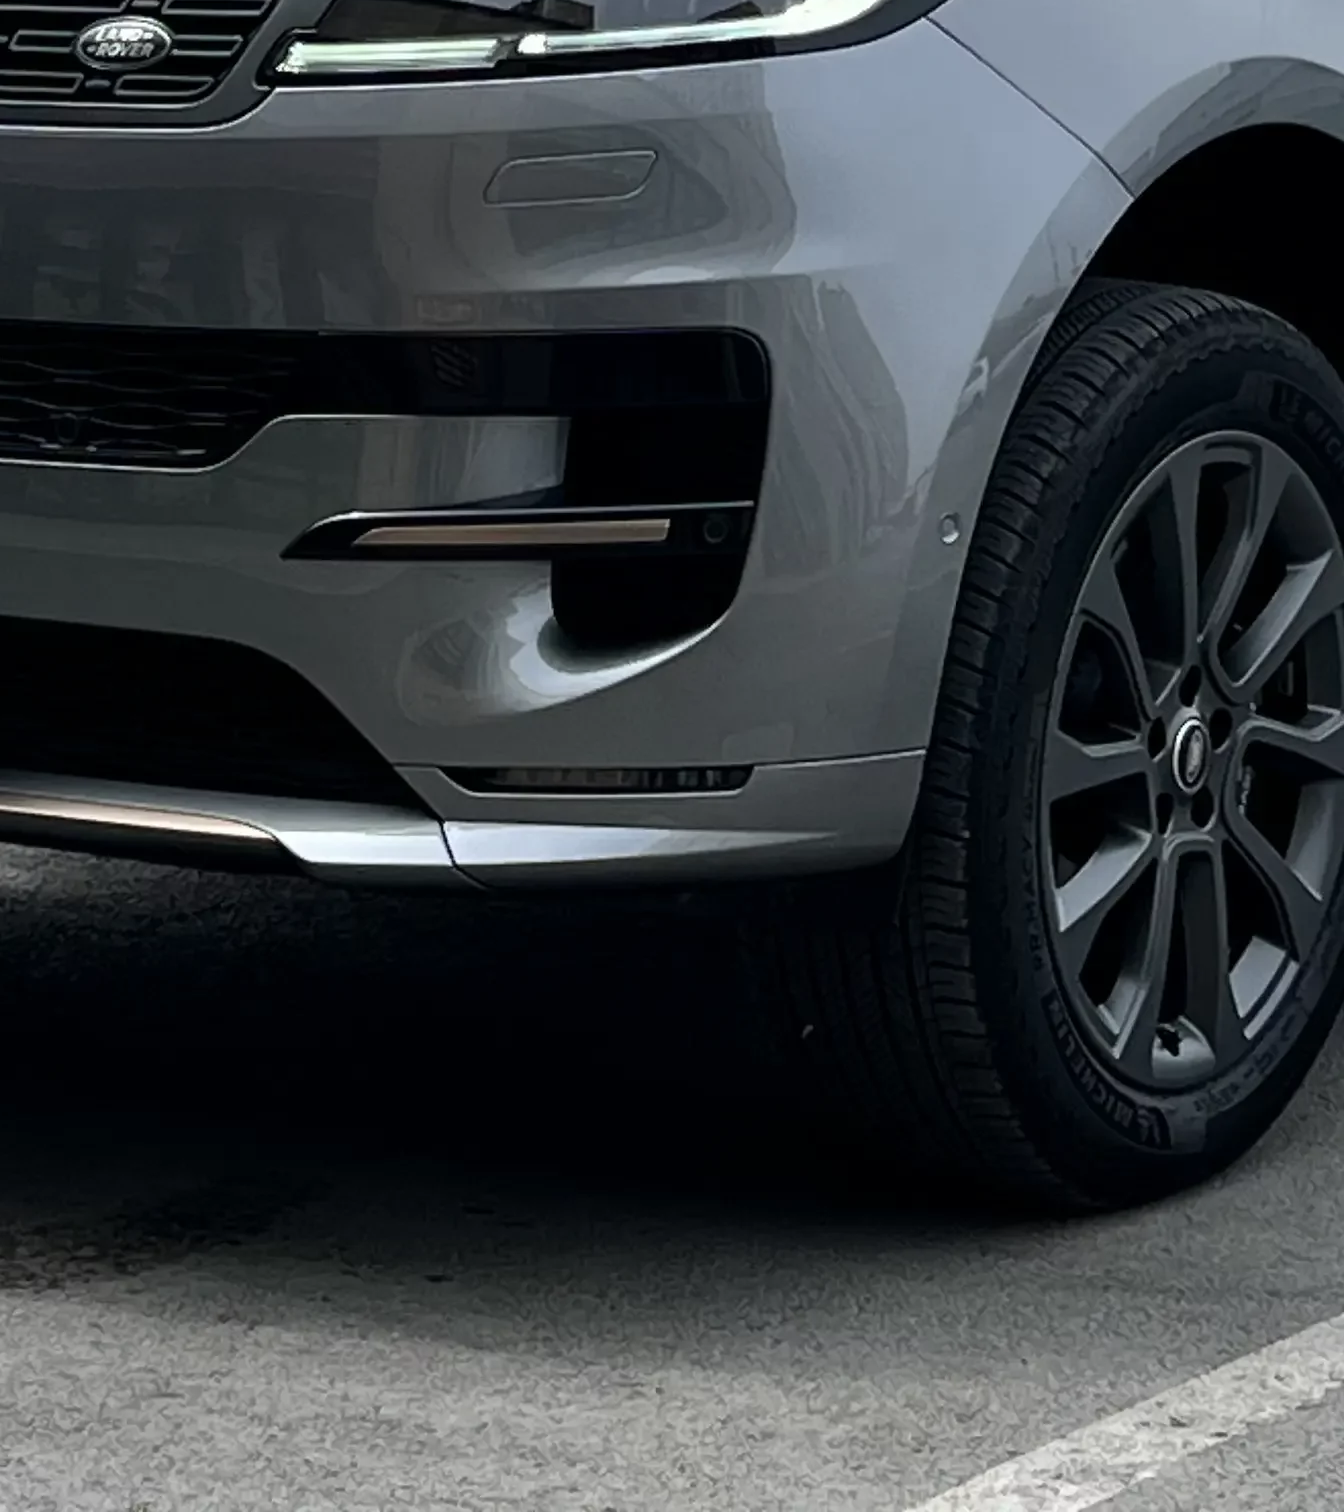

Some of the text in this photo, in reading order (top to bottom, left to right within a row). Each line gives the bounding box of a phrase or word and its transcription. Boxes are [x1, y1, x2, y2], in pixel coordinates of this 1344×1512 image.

[95, 27, 144, 42] LAND
[96, 42, 155, 58] ROVER
[1047, 999, 1134, 1128] MICHELIN
